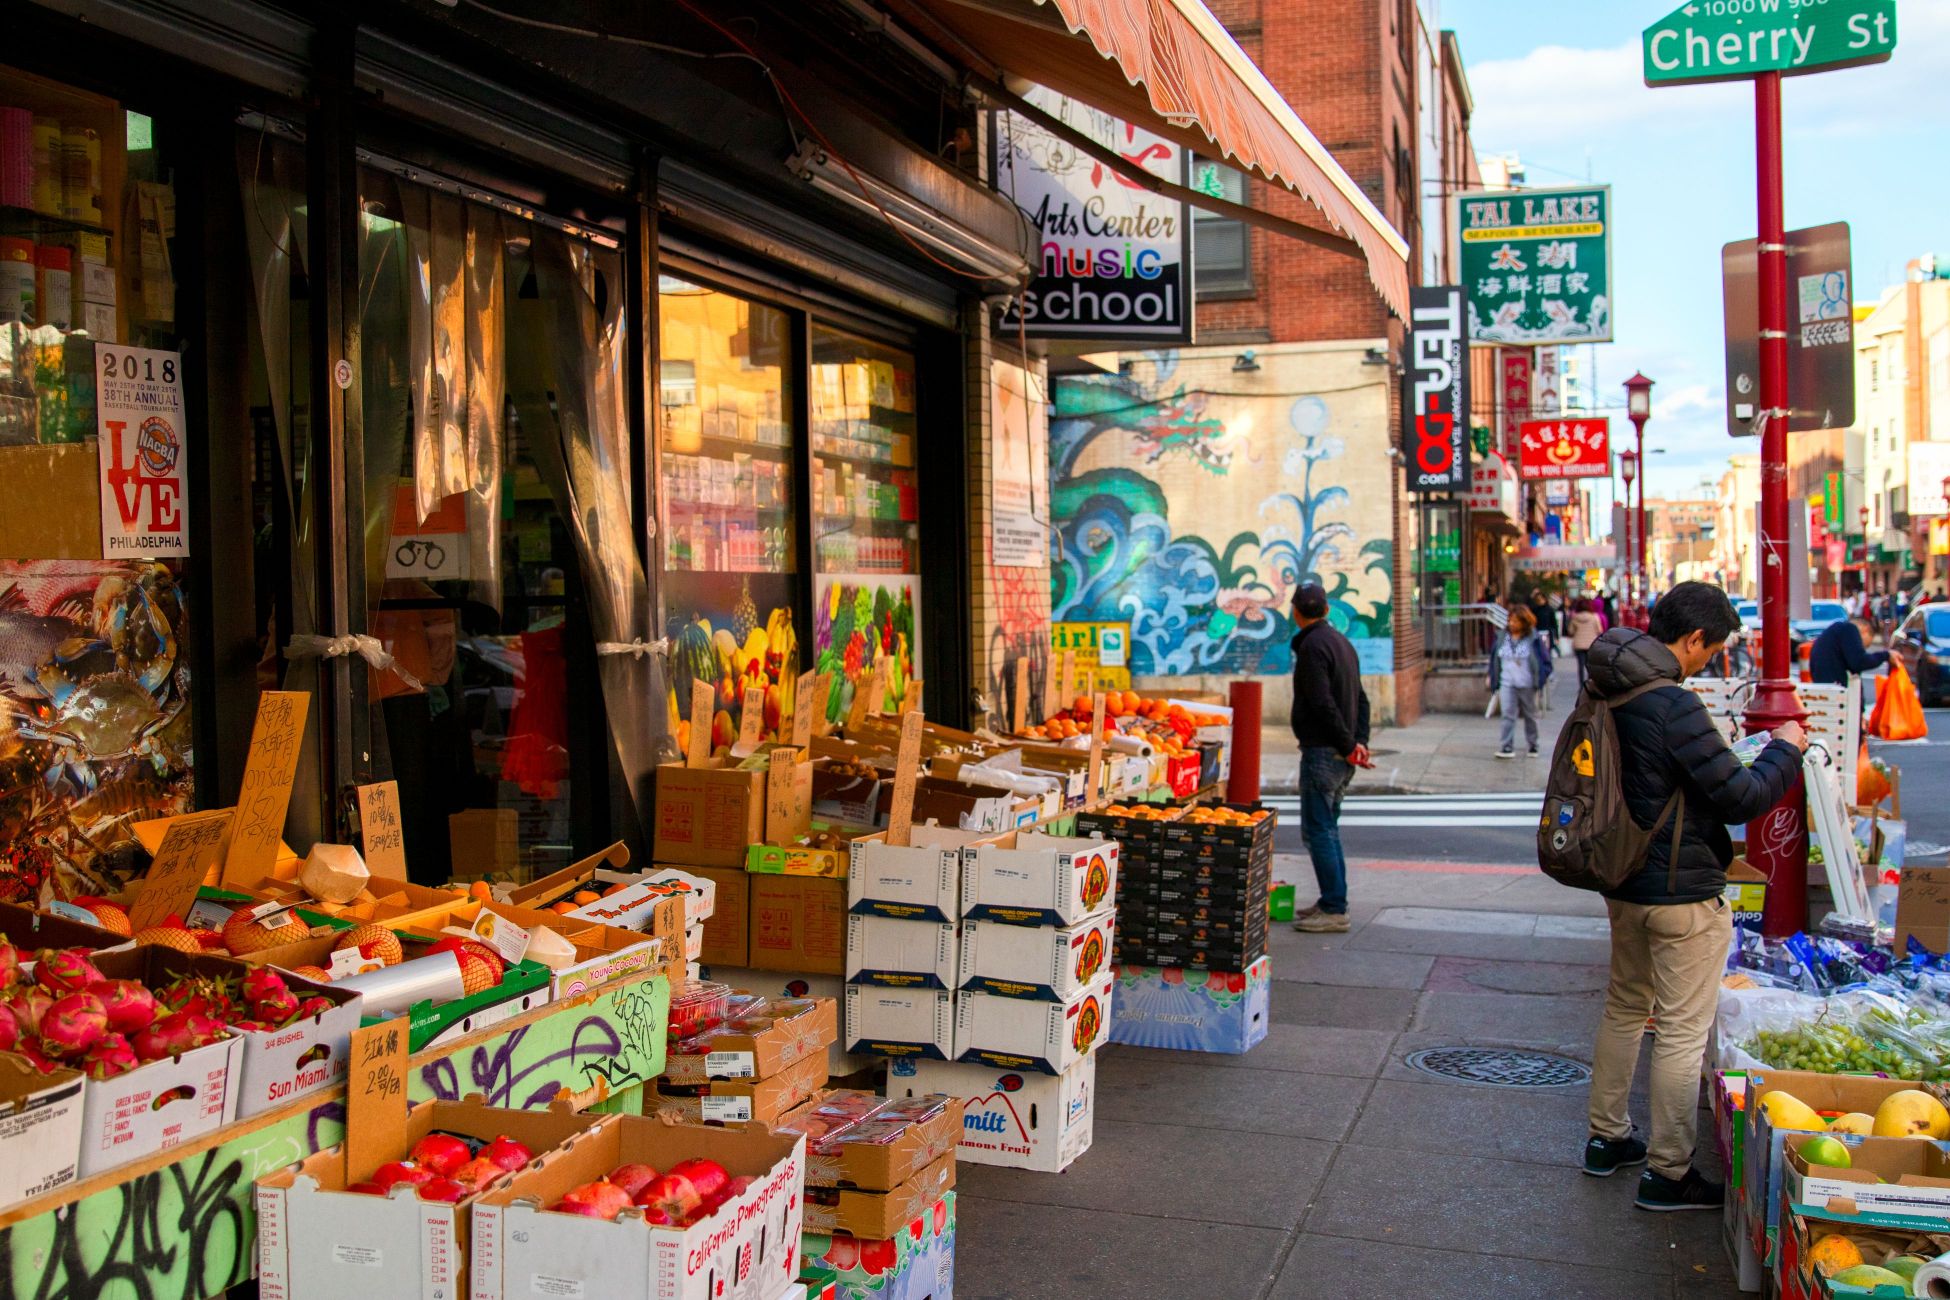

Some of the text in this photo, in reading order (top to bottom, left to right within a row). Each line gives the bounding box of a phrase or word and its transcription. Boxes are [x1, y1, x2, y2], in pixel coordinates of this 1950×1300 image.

[1650, 12, 1890, 71] Cherry St
[1083, 196, 1156, 238] Center
[1466, 195, 1599, 226] TAI LAKE
[1488, 241, 1578, 272] 太湖
[1011, 283, 1153, 322] school
[103, 352, 176, 384] 2018
[104, 389, 179, 406] 38TH ANNUAL
[104, 402, 179, 414] BASKETBALL TOURNAMENT
[139, 429, 176, 465] NACBA
[110, 536, 182, 549] PHILADELPHIA
[589, 953, 647, 981] YOUNG COCONUT
[265, 1031, 305, 1050] 3/4 BUSHEL
[115, 1090, 152, 1108] GREEN SQUASH
[268, 1081, 292, 1101] Sun
[115, 1103, 148, 1119] SMALL FANCY
[114, 1119, 131, 1132] FANCY
[162, 1122, 183, 1138] PRODUCE
[113, 1132, 135, 1145] MEDIUM
[958, 1141, 998, 1151] amous
[428, 1218, 449, 1226] COUNT
[475, 1211, 496, 1219] COUNT
[687, 1160, 795, 1276] California Pomegranates
